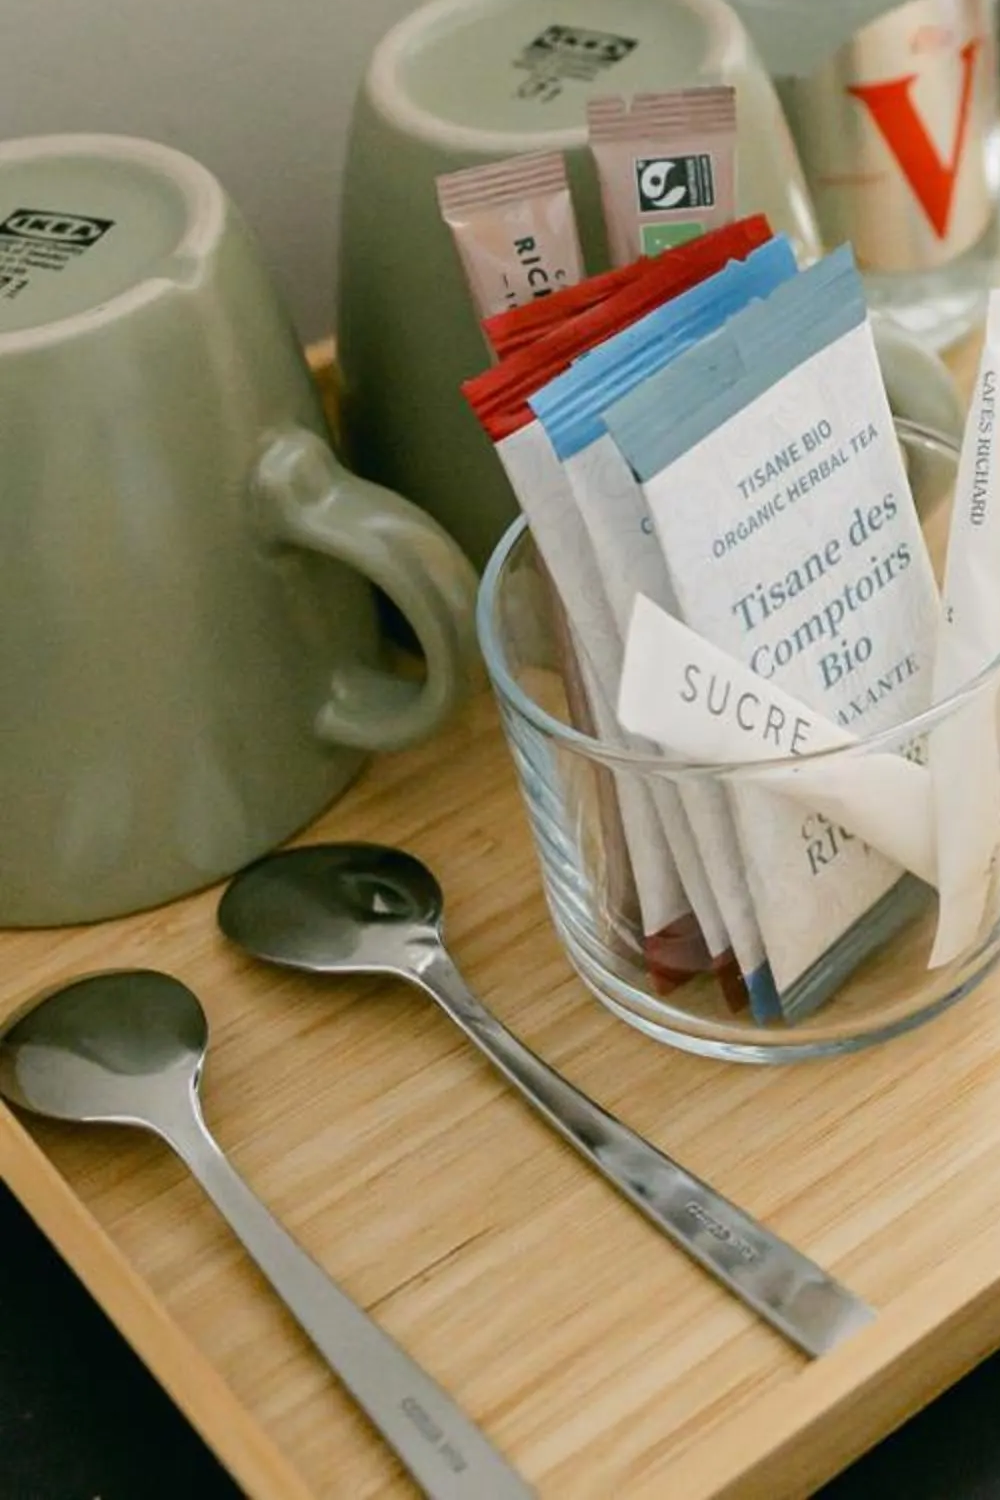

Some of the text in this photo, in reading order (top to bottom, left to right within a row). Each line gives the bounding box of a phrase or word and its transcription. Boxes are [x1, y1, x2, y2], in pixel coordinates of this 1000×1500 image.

[847, 36, 981, 239] V
[712, 423, 878, 559] ORGANIC HERBAL TEA
[737, 419, 832, 500] TISANE BIO
[969, 437, 991, 526] RICHARD
[732, 492, 898, 632] Tisane des
[749, 542, 912, 679] Comptoirs
[818, 636, 873, 691] Bio
[838, 653, 920, 726] AXANTE
[680, 664, 811, 756] SUCRE
